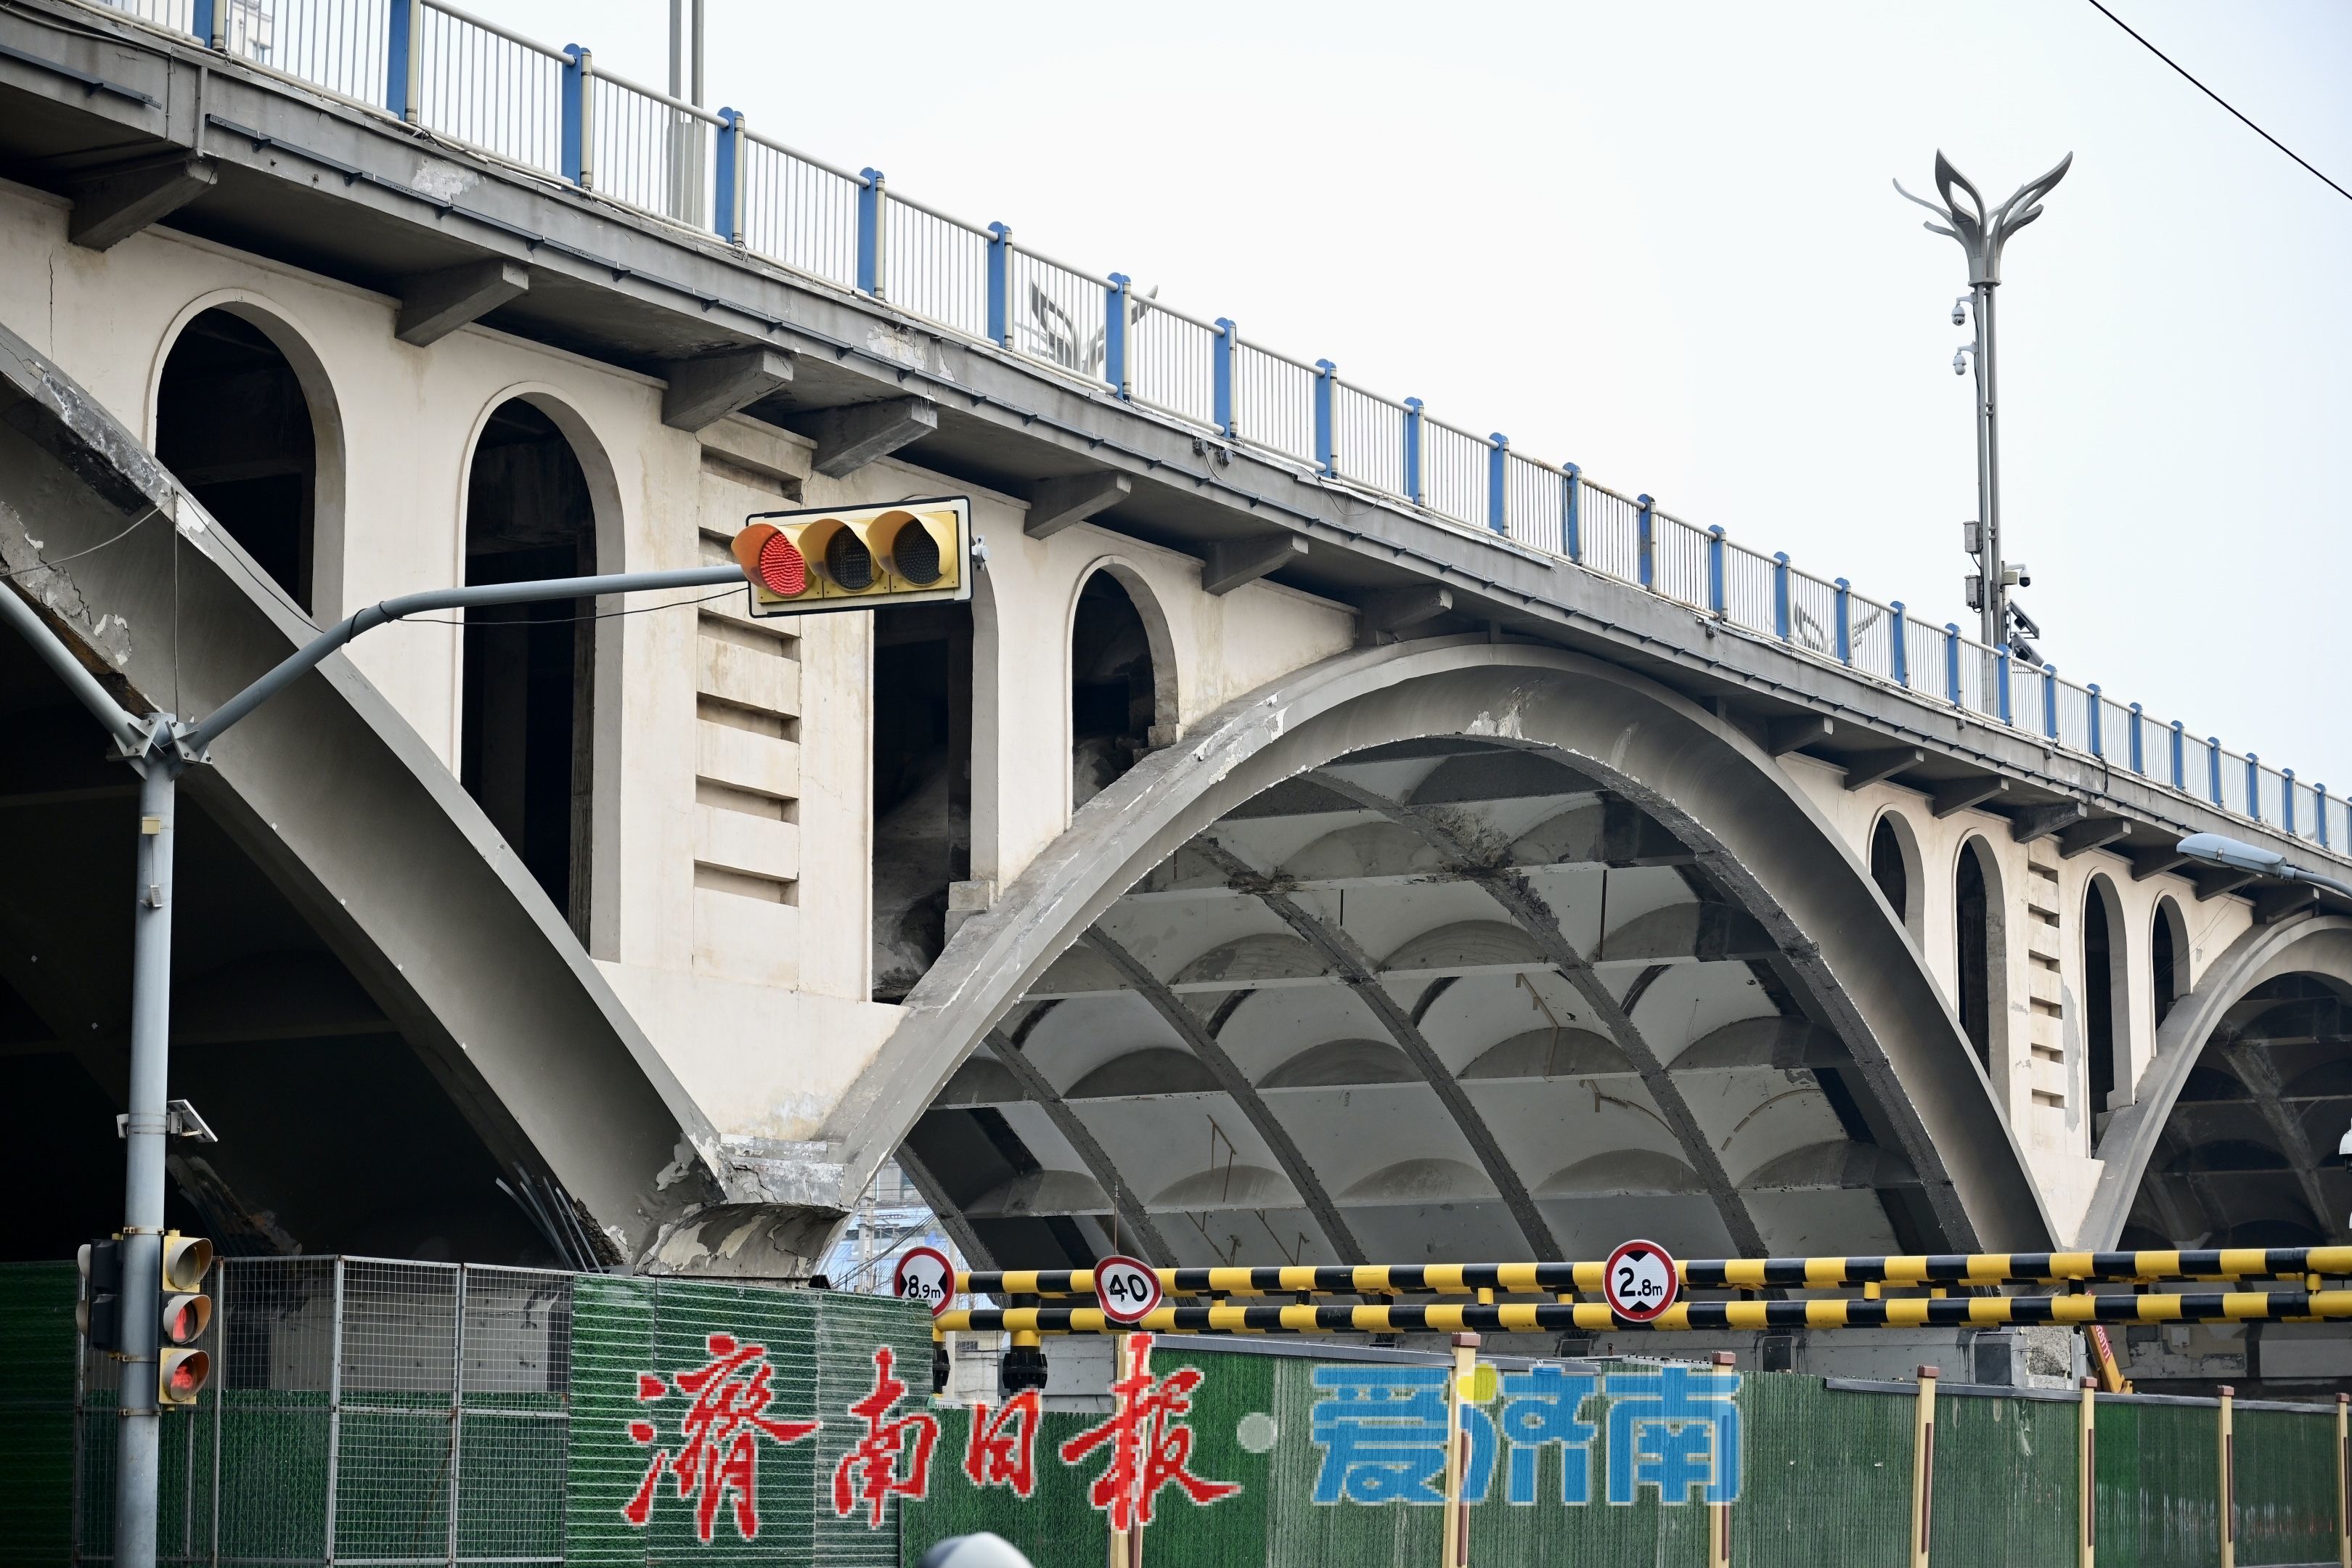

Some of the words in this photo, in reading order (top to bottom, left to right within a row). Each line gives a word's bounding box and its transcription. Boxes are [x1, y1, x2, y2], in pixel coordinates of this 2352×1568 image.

[908, 1275, 940, 1299] 8.9m
[1109, 1274, 1147, 1302] 40
[1618, 1267, 1662, 1297] 2.8m
